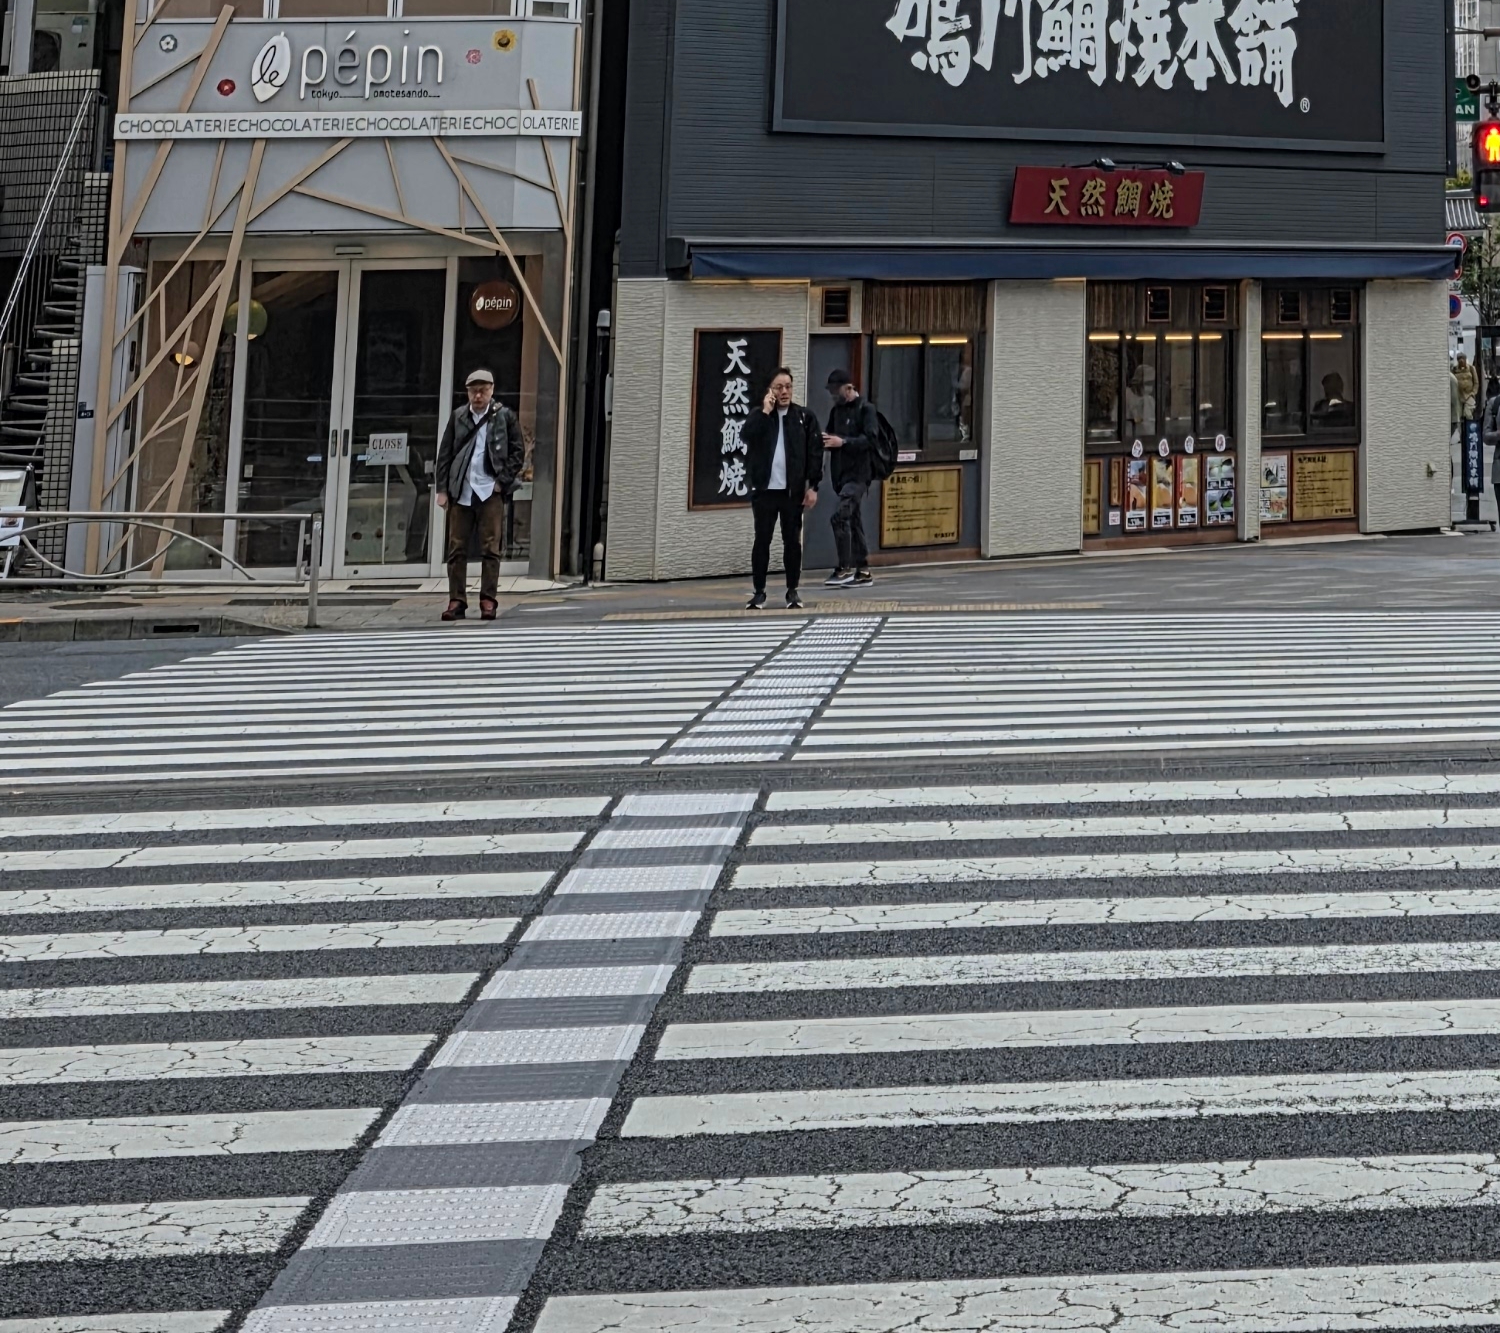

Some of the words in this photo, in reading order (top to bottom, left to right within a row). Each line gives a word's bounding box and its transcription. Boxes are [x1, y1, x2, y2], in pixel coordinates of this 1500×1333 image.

[300, 29, 443, 100] pépin
[311, 89, 339, 99] tokyo
[373, 89, 429, 99] omotesando
[1043, 177, 1175, 220] 天然鯛焼
[718, 338, 751, 497] 天然鯛焼
[372, 438, 403, 451] CLOSE
